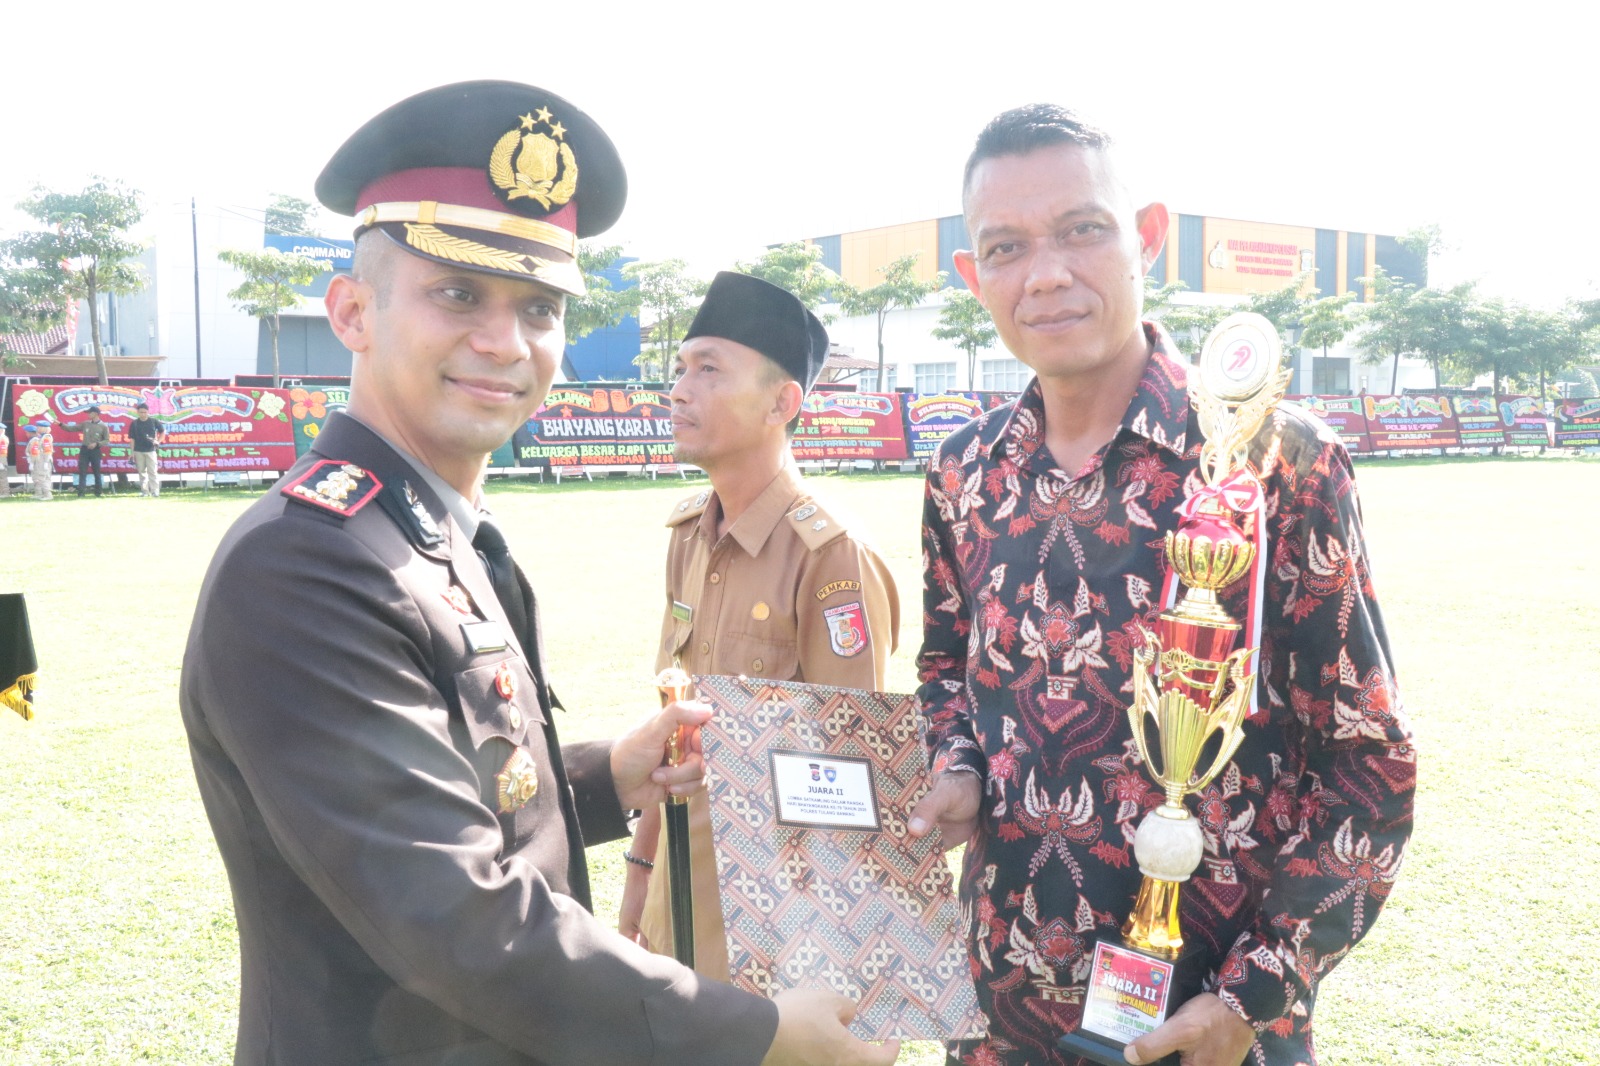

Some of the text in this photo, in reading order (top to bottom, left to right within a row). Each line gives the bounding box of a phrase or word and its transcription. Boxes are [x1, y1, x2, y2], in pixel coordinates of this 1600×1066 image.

[293, 245, 352, 259] COMMAND
[65, 393, 238, 408] SELAMAT SUKSES
[545, 392, 660, 408] SELAMAT HARI
[836, 398, 880, 410] SUKSES
[230, 422, 252, 432] 79
[521, 443, 675, 459] KELUARGA BESAR RAPI WILA
[550, 456, 578, 466] DICKY
[818, 581, 857, 598] PEMKAB
[808, 785, 844, 796] JUARA II
[1101, 972, 1158, 1002] JUARA II
